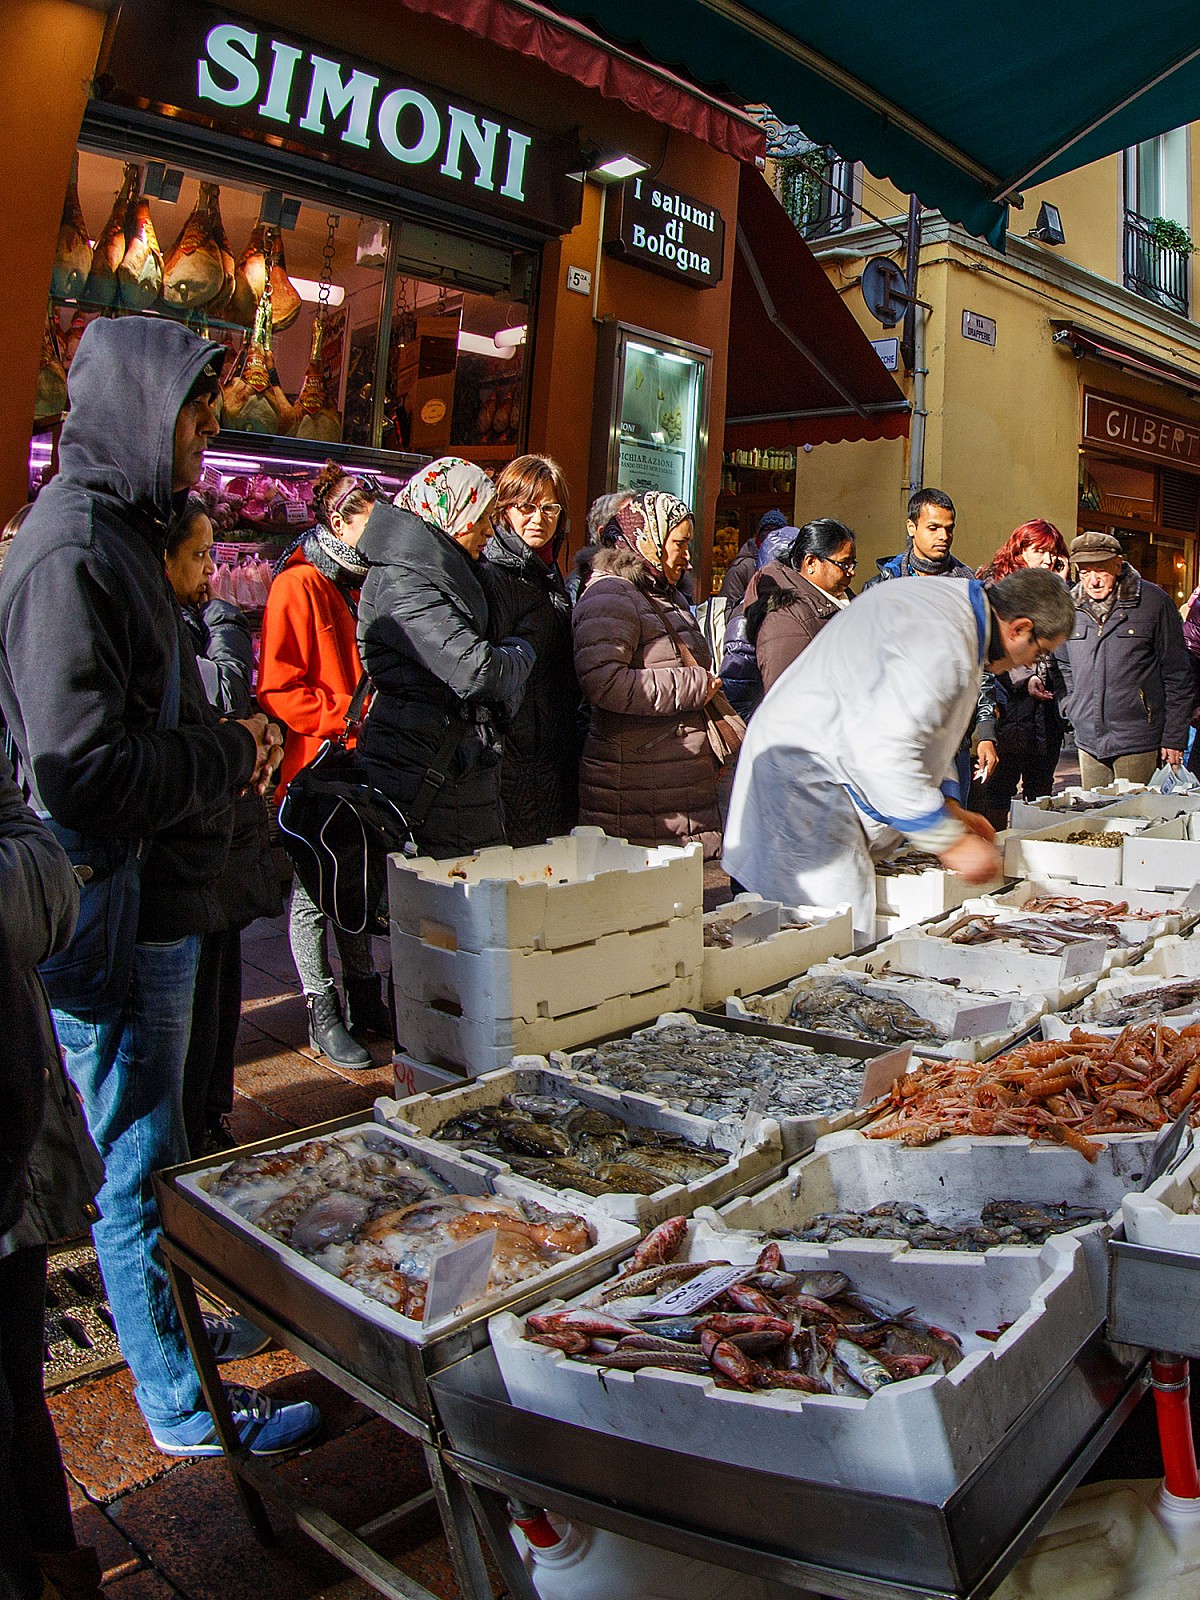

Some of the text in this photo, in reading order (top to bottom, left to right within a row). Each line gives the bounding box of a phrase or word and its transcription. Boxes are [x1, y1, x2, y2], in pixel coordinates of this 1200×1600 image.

[198, 24, 532, 202] SIMONI
[633, 177, 715, 232] I salumi
[665, 219, 684, 244] di
[632, 223, 711, 275] Bologna
[967, 327, 991, 342] DRAPPERIE
[975, 319, 985, 329] VIA
[619, 453, 674, 469] ICHIARAZIONE
